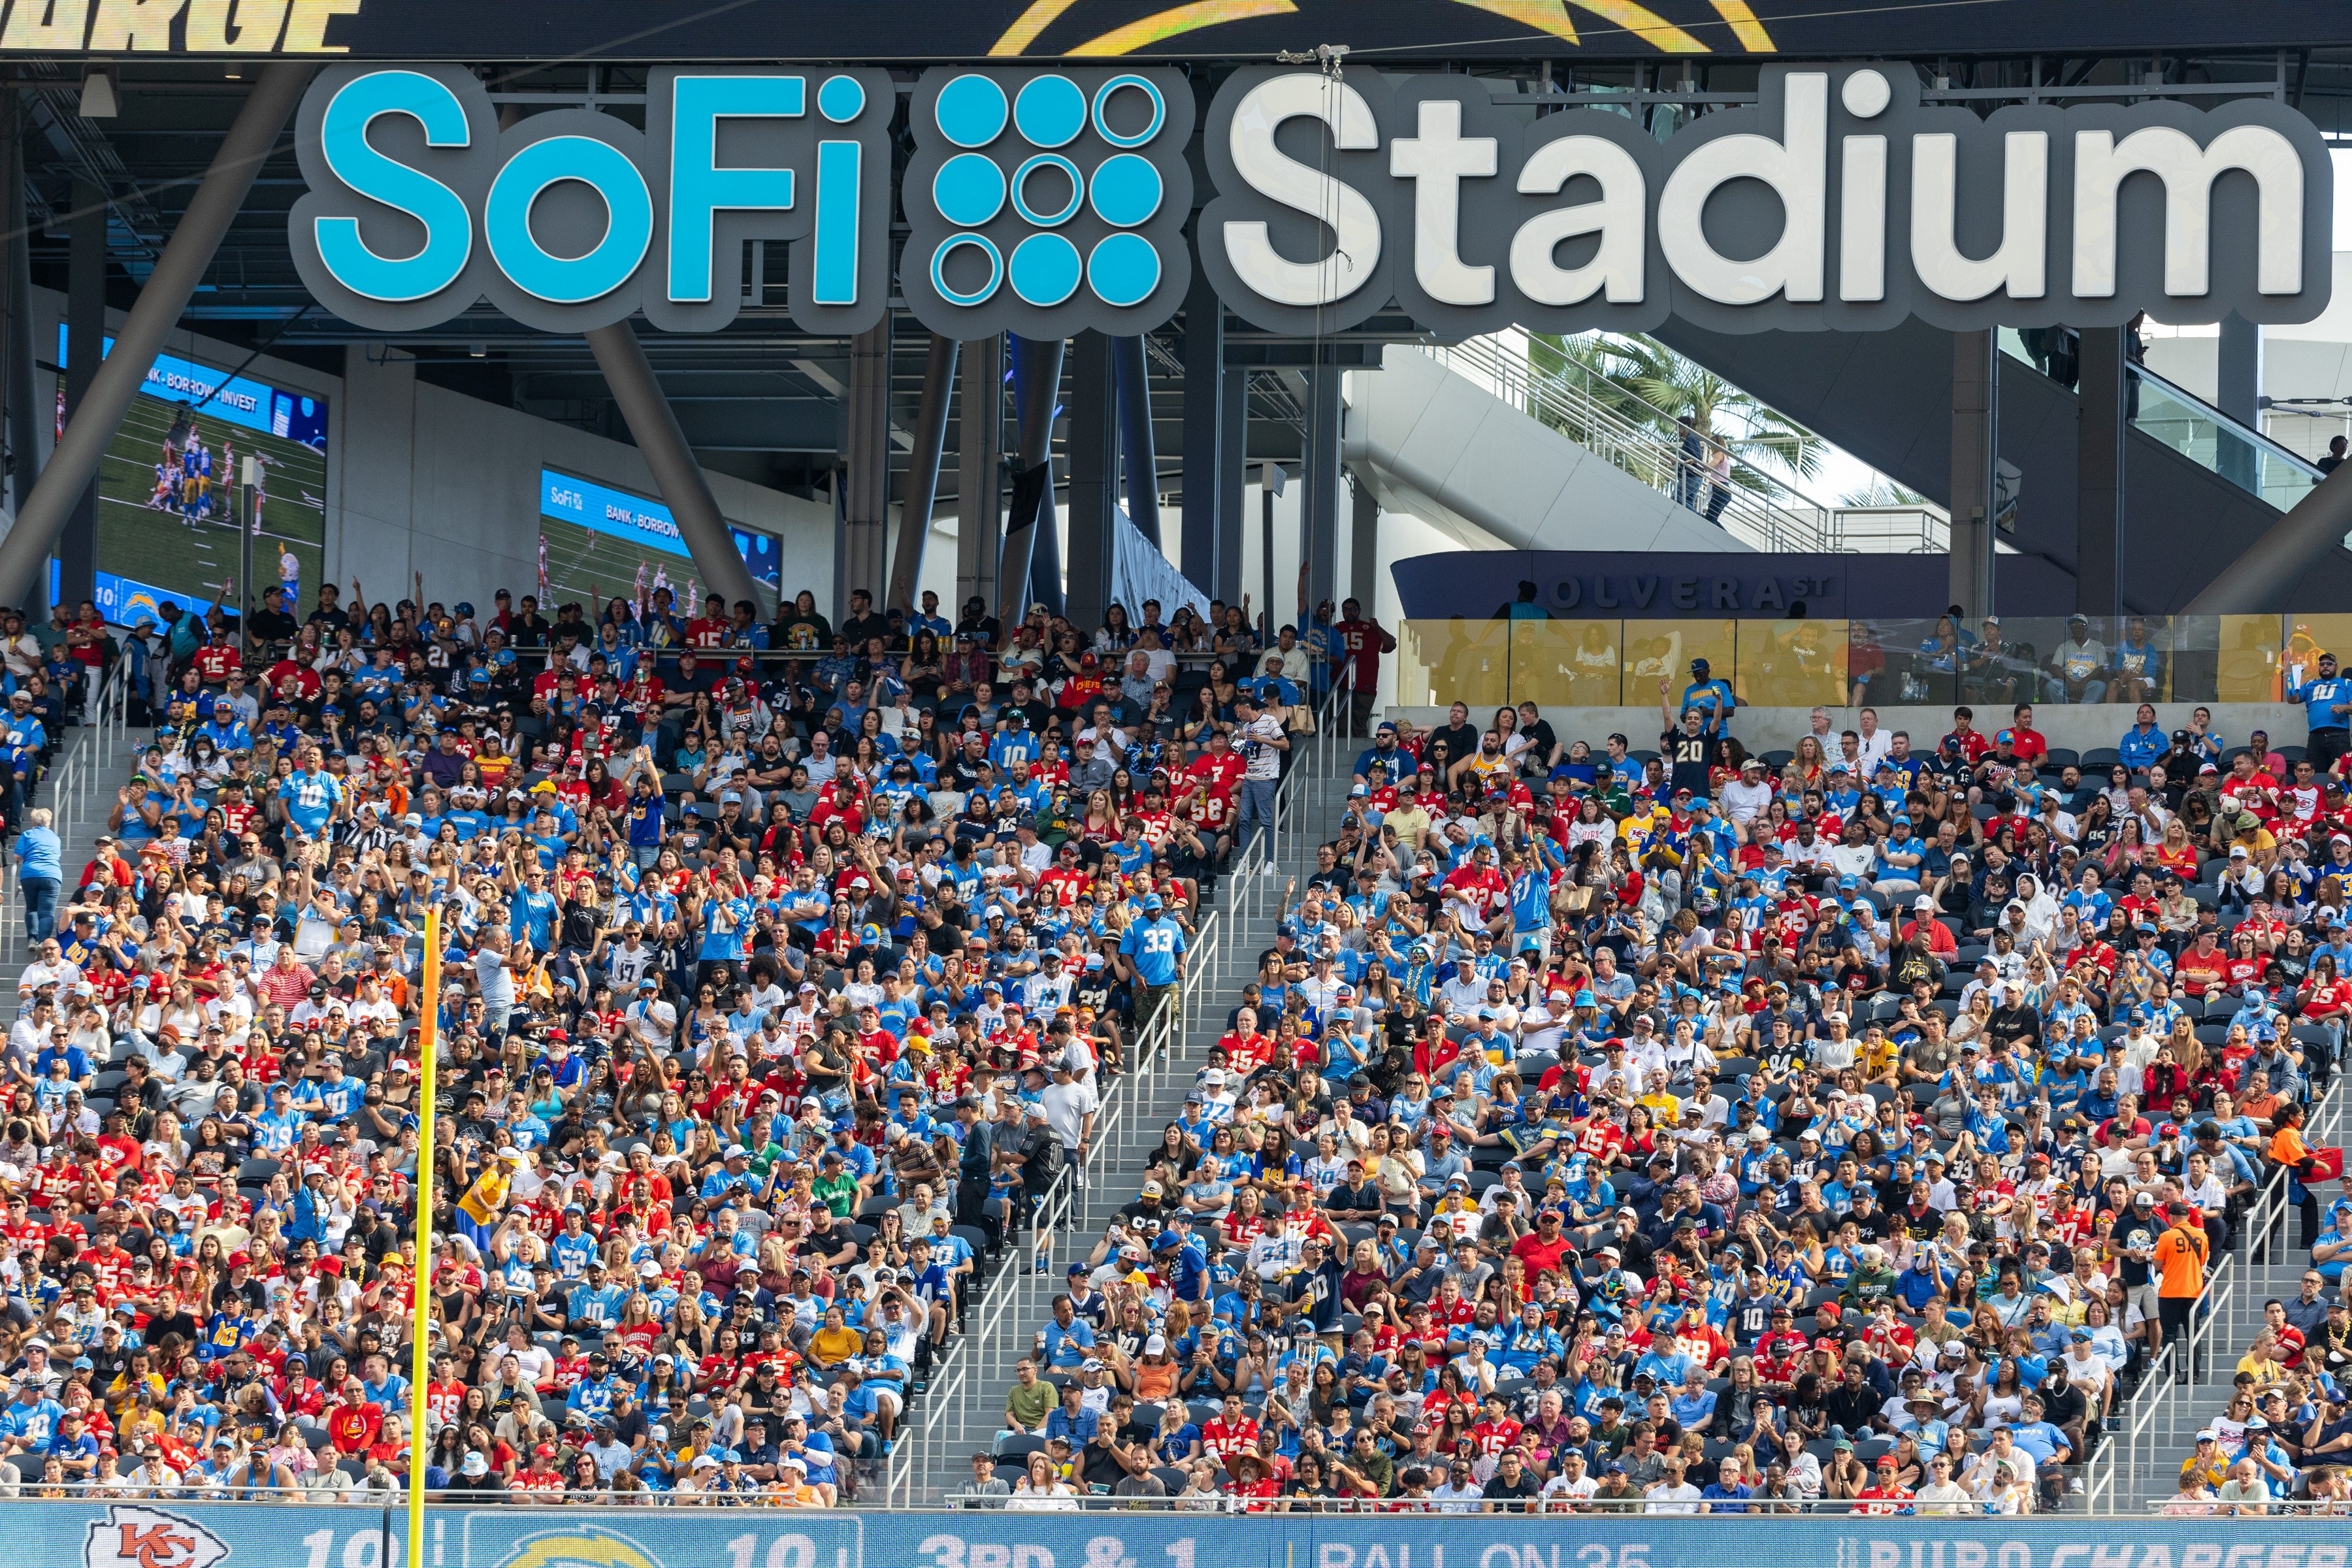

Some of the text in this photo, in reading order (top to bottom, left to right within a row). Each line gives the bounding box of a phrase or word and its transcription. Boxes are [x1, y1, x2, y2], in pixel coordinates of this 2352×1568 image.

[314, 69, 2304, 306] SoFi Stadium
[167, 372, 216, 397] BORROW
[221, 392, 257, 412] INVEST
[551, 486, 572, 508] SoFi
[606, 504, 679, 538] BANK BORROW
[96, 587, 113, 603] 10
[1548, 575, 1829, 610] OLVERA ST
[699, 633, 719, 648] 15
[1343, 632, 1362, 649] 15
[203, 657, 224, 674] 15
[428, 646, 449, 667] 21
[1077, 681, 1100, 690] CHIEFS
[1004, 747, 1026, 767] 10
[1676, 742, 1703, 762] 20
[1212, 766, 1223, 782] 7
[298, 784, 324, 806] 10
[1190, 798, 1222, 815] 58
[224, 813, 242, 834] 15
[1141, 822, 1168, 842] 25
[2068, 825, 2074, 834] LA
[1633, 830, 1646, 838] KC
[1053, 879, 1078, 897] 74
[1783, 911, 1809, 933] 35
[1143, 929, 1173, 953] 33
[66, 942, 90, 964] 10
[619, 964, 636, 982] 17
[93, 985, 114, 1000] 64
[1079, 990, 1107, 1013] 33
[2310, 987, 2336, 1004] 15
[796, 1022, 811, 1033] 15
[1232, 1050, 1252, 1070] 15
[1770, 1054, 1791, 1073] 84
[246, 1068, 261, 1082] 15
[325, 1091, 348, 1110] 10
[269, 1130, 291, 1151] 19
[1023, 1141, 1033, 1151] 10
[1582, 1128, 1605, 1152] 15
[1049, 1143, 1064, 1172] 10
[1950, 1160, 1974, 1180] 33
[43, 1181, 69, 1198] 29
[533, 1219, 553, 1239] 15
[1237, 1226, 1255, 1243] 15
[561, 1250, 587, 1273] 52
[1258, 1245, 1290, 1262] 33
[1830, 1258, 1845, 1272] 11
[1858, 1286, 1887, 1295] PACKERS
[585, 1302, 604, 1320] 10
[1743, 1308, 1765, 1330] 10
[212, 1324, 238, 1347] 10
[623, 1333, 652, 1344] KANSAS CITY
[1675, 1339, 1710, 1367] 88
[430, 1394, 459, 1420] 88
[27, 1417, 50, 1438] 10
[1217, 1437, 1243, 1456] 15
[1481, 1436, 1506, 1458] 15
[119, 1523, 195, 1568] KC
